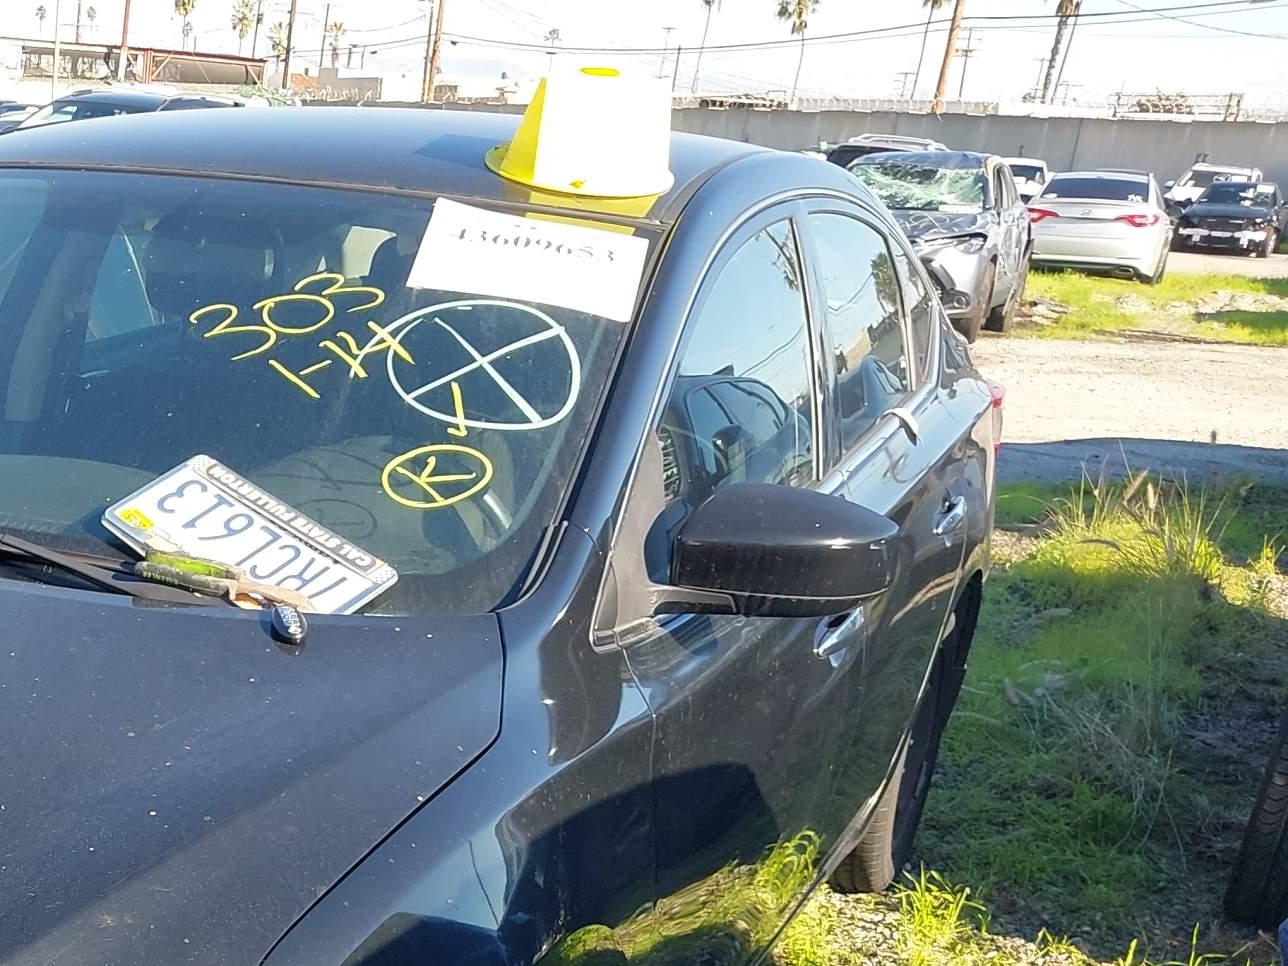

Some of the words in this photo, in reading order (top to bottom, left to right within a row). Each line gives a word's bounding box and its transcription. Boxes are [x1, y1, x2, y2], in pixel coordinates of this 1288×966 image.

[189, 271, 385, 360] 303
[204, 464, 298, 521] FULLERTON
[288, 515, 343, 549] STATE
